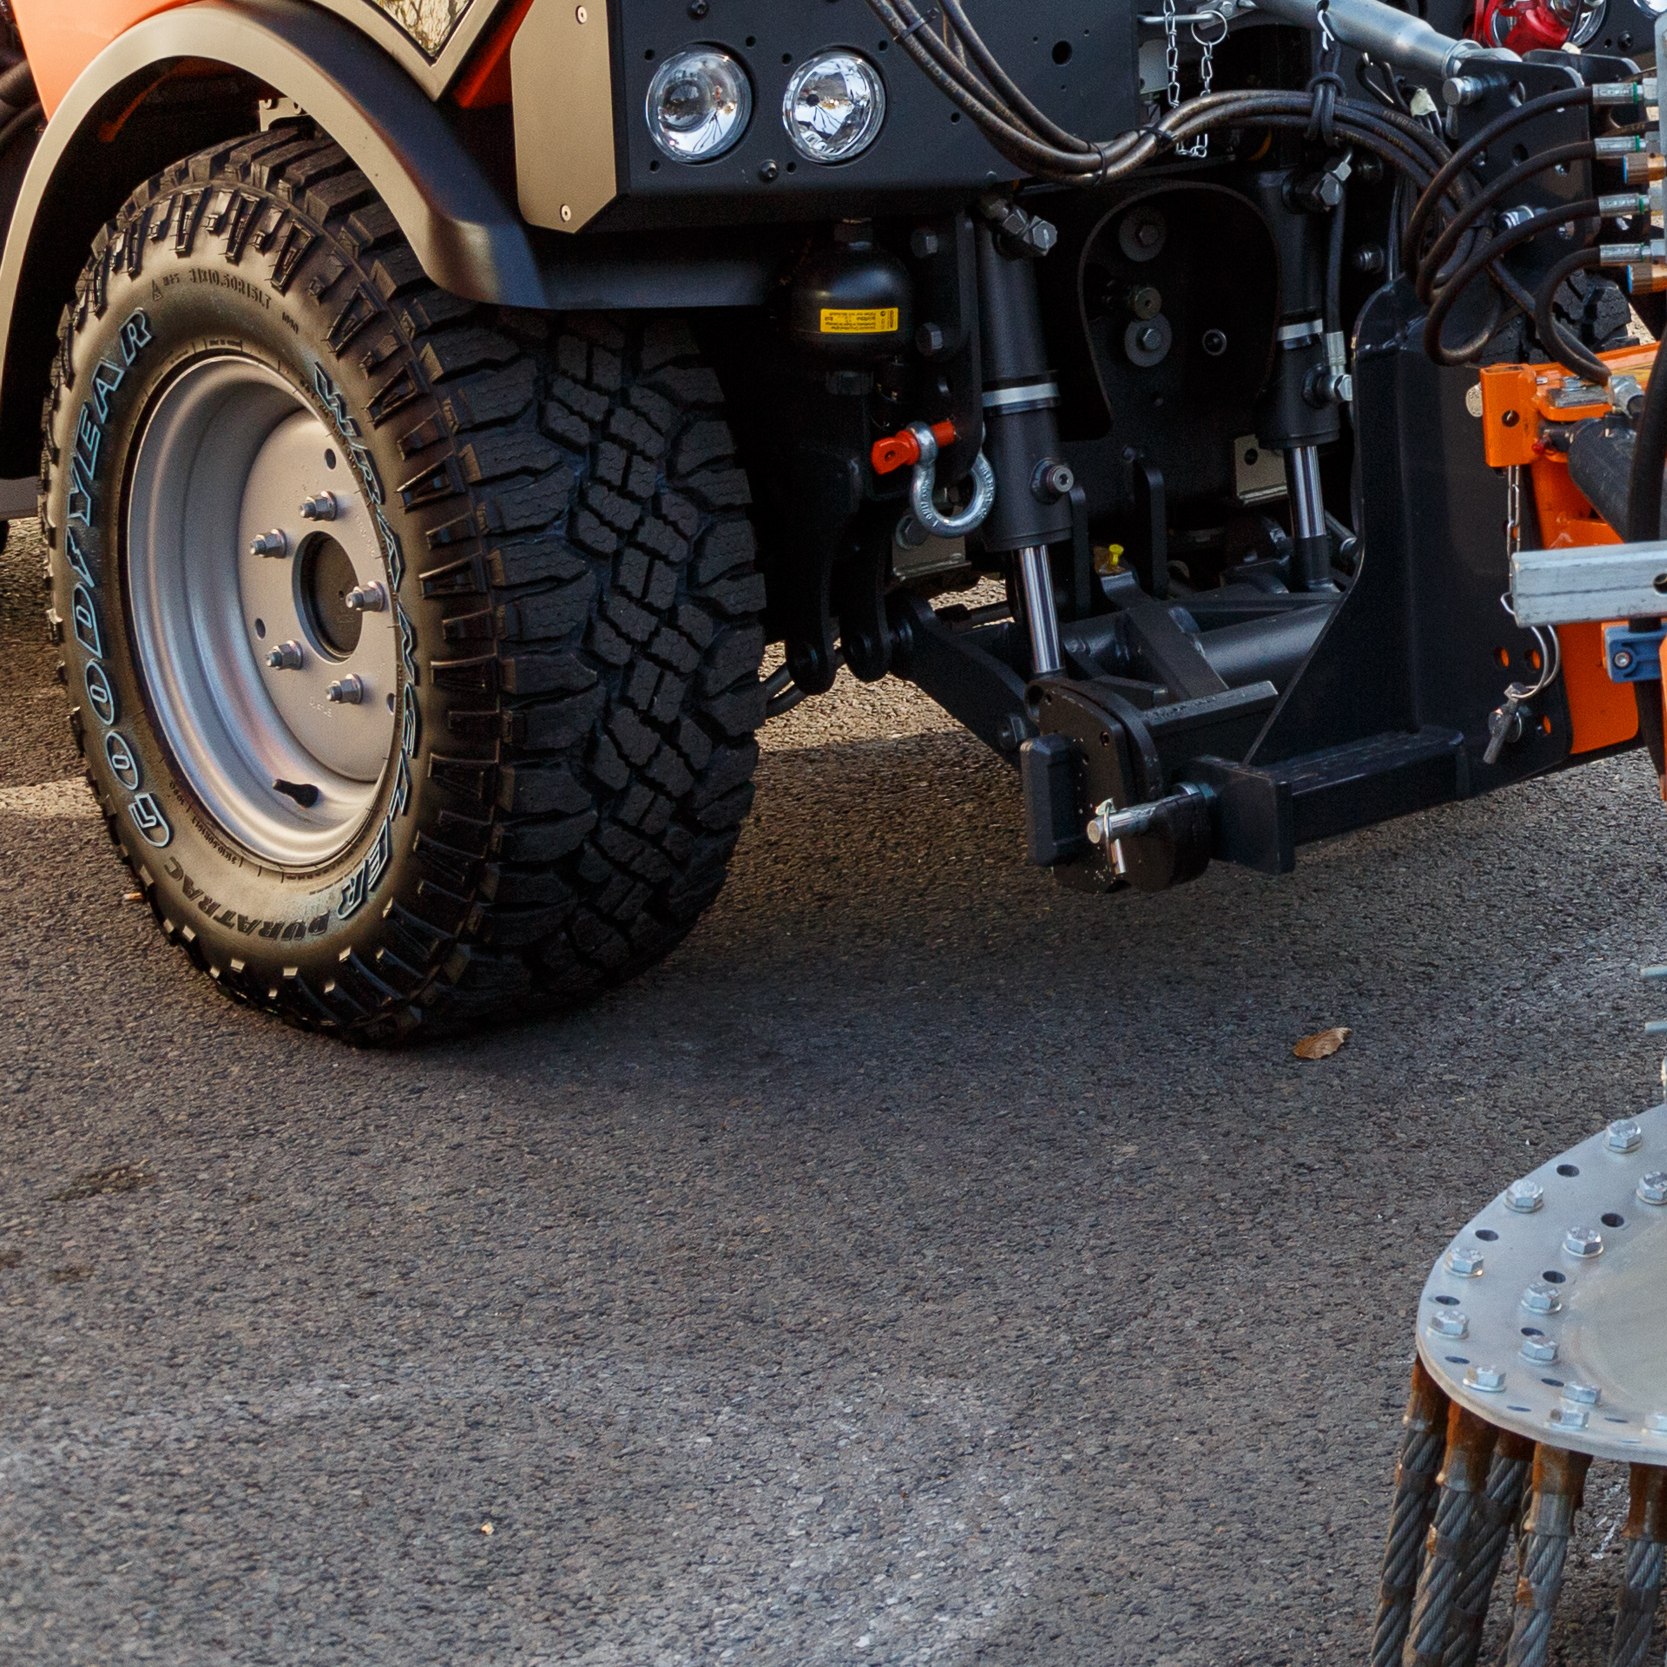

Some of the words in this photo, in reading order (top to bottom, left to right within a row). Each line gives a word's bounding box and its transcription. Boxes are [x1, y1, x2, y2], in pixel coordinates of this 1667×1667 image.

[64, 306, 170, 849] GOODYEAR
[313, 360, 424, 920] WRANGLER
[164, 856, 330, 942] DURATRAC
